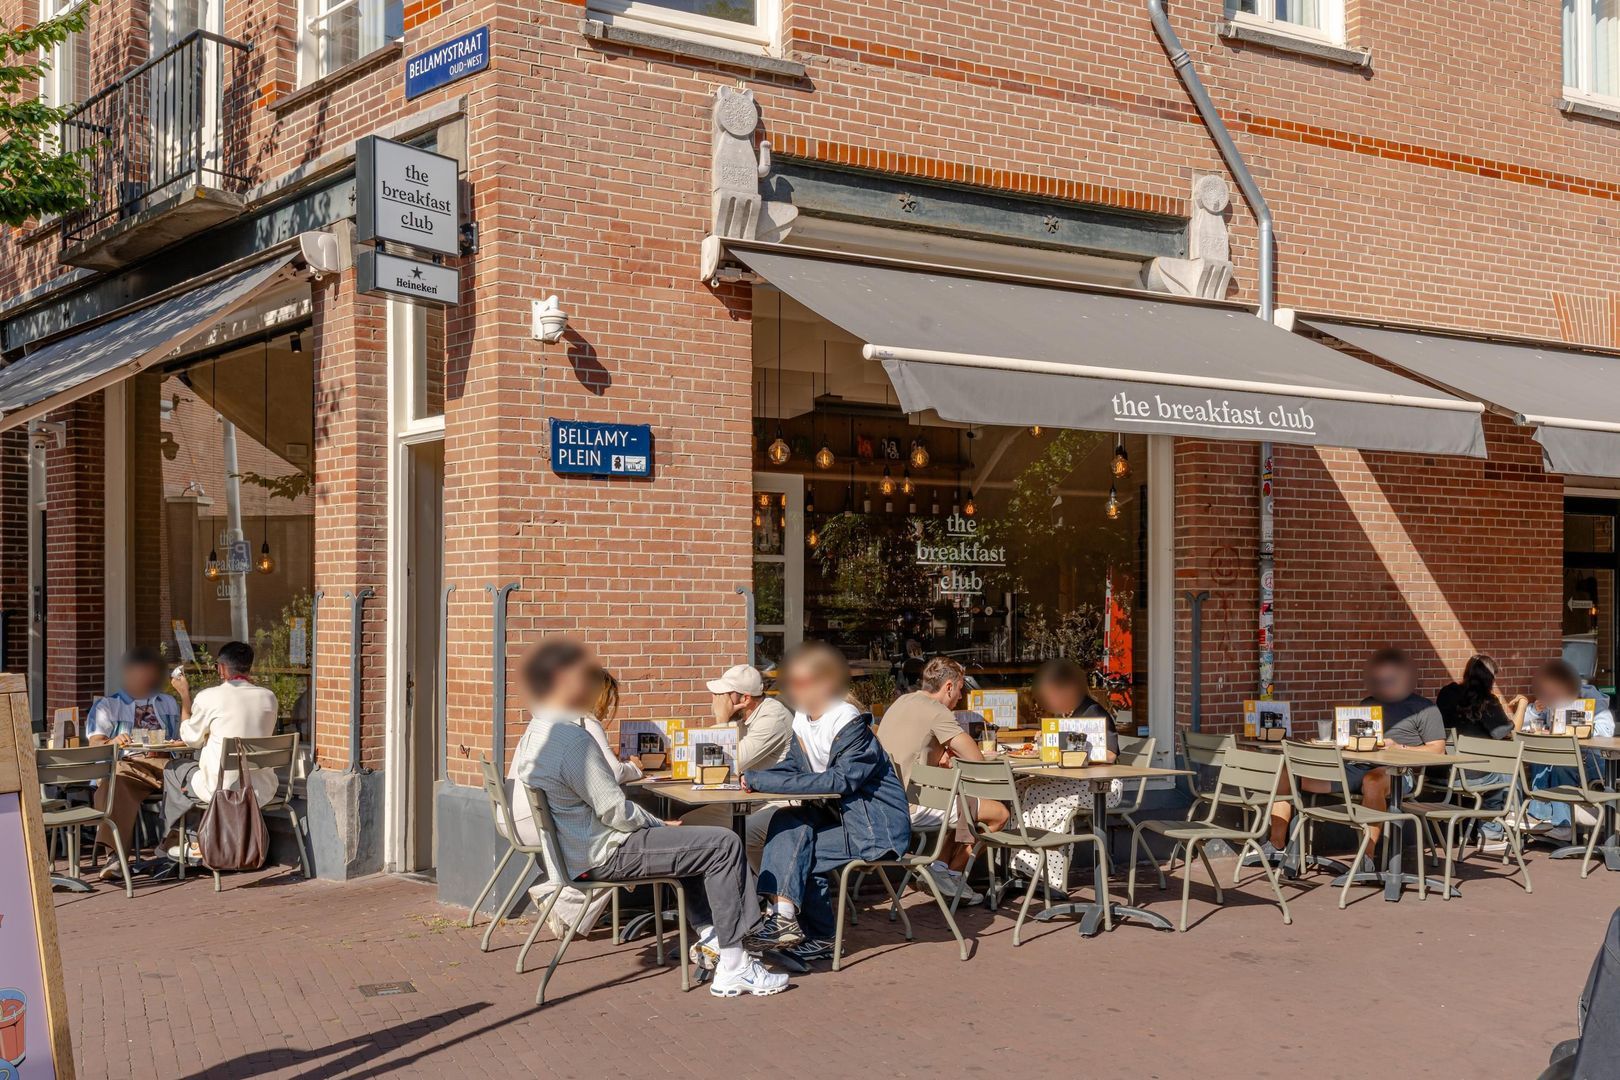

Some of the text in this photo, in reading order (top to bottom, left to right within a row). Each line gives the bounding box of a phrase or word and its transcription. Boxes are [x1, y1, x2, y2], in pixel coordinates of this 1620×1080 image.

[409, 33, 483, 79] BELLAMYSTRAAT
[449, 53, 483, 76] OUD-WEST
[405, 164, 429, 183] the
[381, 180, 452, 213] breakfast
[400, 211, 434, 232] club
[396, 277, 438, 295] Heineken
[1111, 391, 1315, 431] the breakfast club
[558, 427, 638, 448] BELLAMY-
[558, 448, 601, 467] PLEIN
[946, 512, 977, 533] the
[916, 540, 1007, 562] breakfast
[940, 569, 983, 590] club
